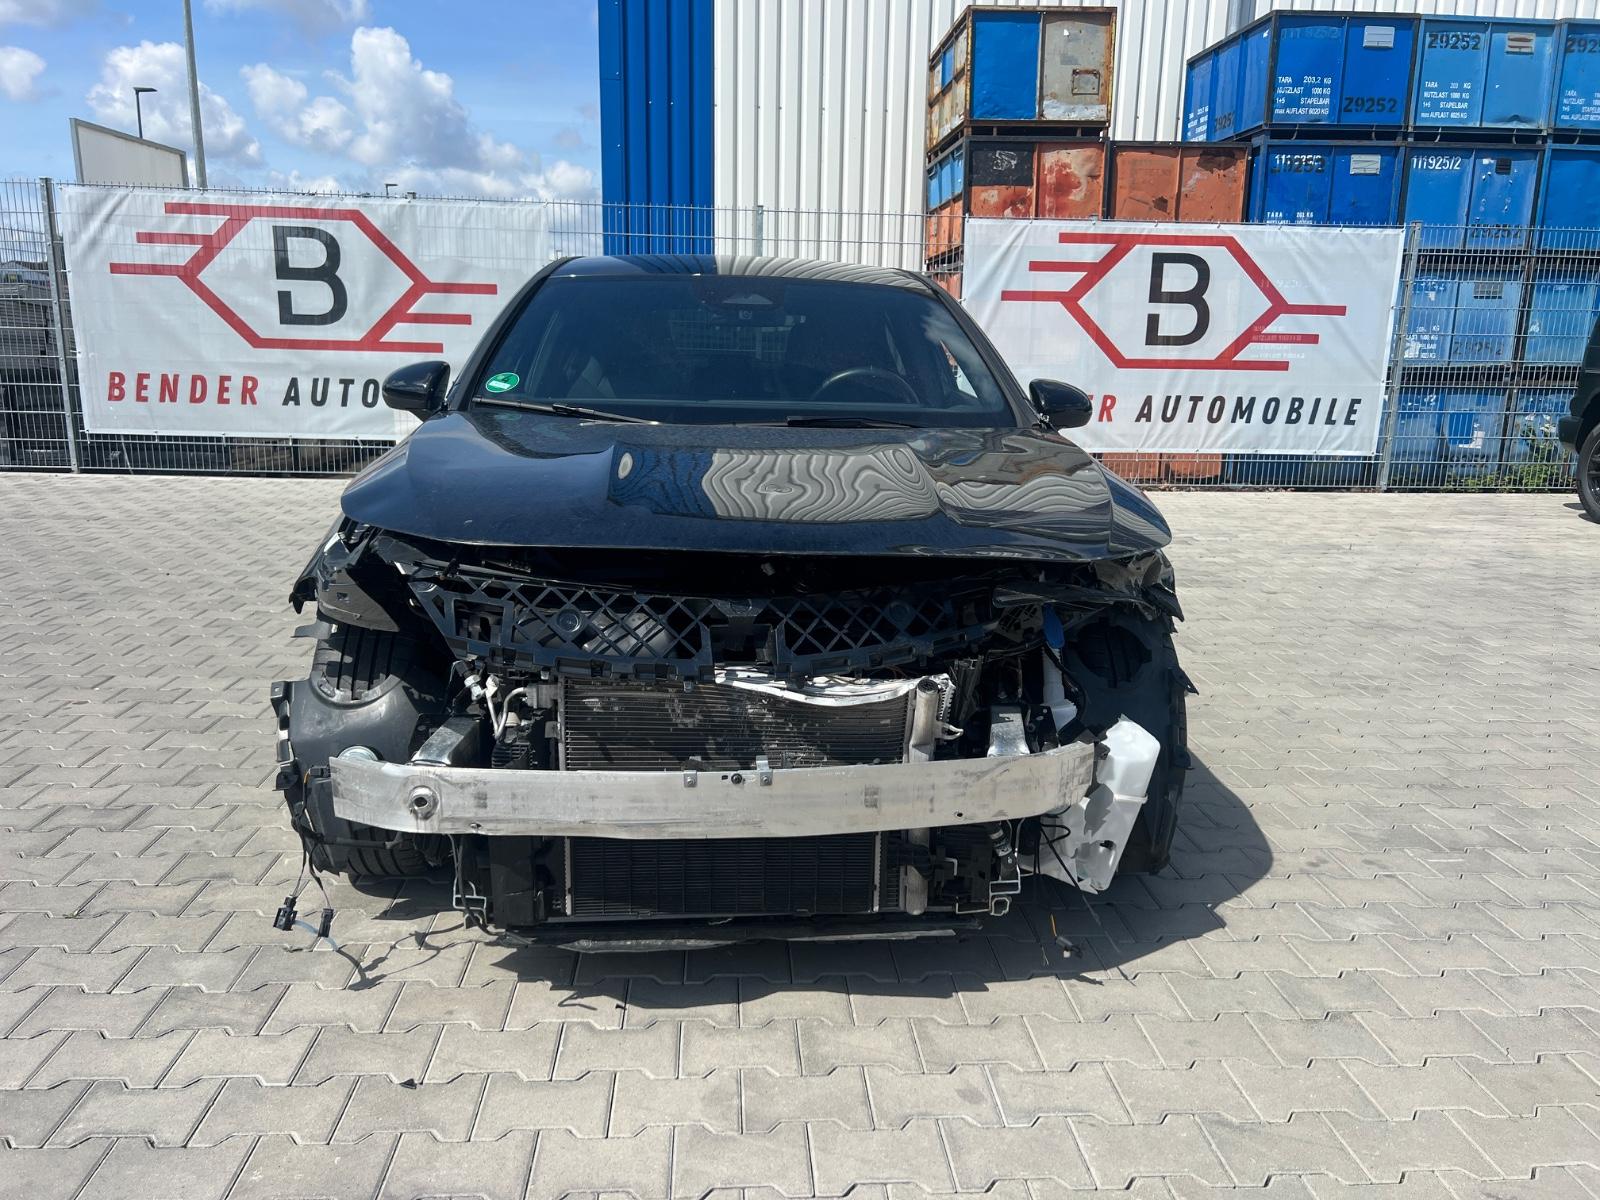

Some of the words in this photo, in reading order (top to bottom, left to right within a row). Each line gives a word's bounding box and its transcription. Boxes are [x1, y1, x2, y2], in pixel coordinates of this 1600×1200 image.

[1278, 76, 1293, 84] TARA
[1323, 77, 1332, 85] KG
[1276, 86, 1304, 94] NUTZLAST
[1323, 87, 1331, 95] KG
[1423, 91, 1448, 99] NUTZLAST
[1300, 97, 1330, 105] STAPELBAR
[1439, 101, 1469, 109] STAPELBAR
[1285, 107, 1309, 115] AUFLAST
[1411, 155, 1462, 170] 111925/2
[272, 225, 348, 326] B
[1145, 252, 1210, 346] B
[107, 371, 259, 406] BENDER
[282, 377, 380, 409] AUTO
[1134, 395, 1362, 426] AUTOMOBILE
